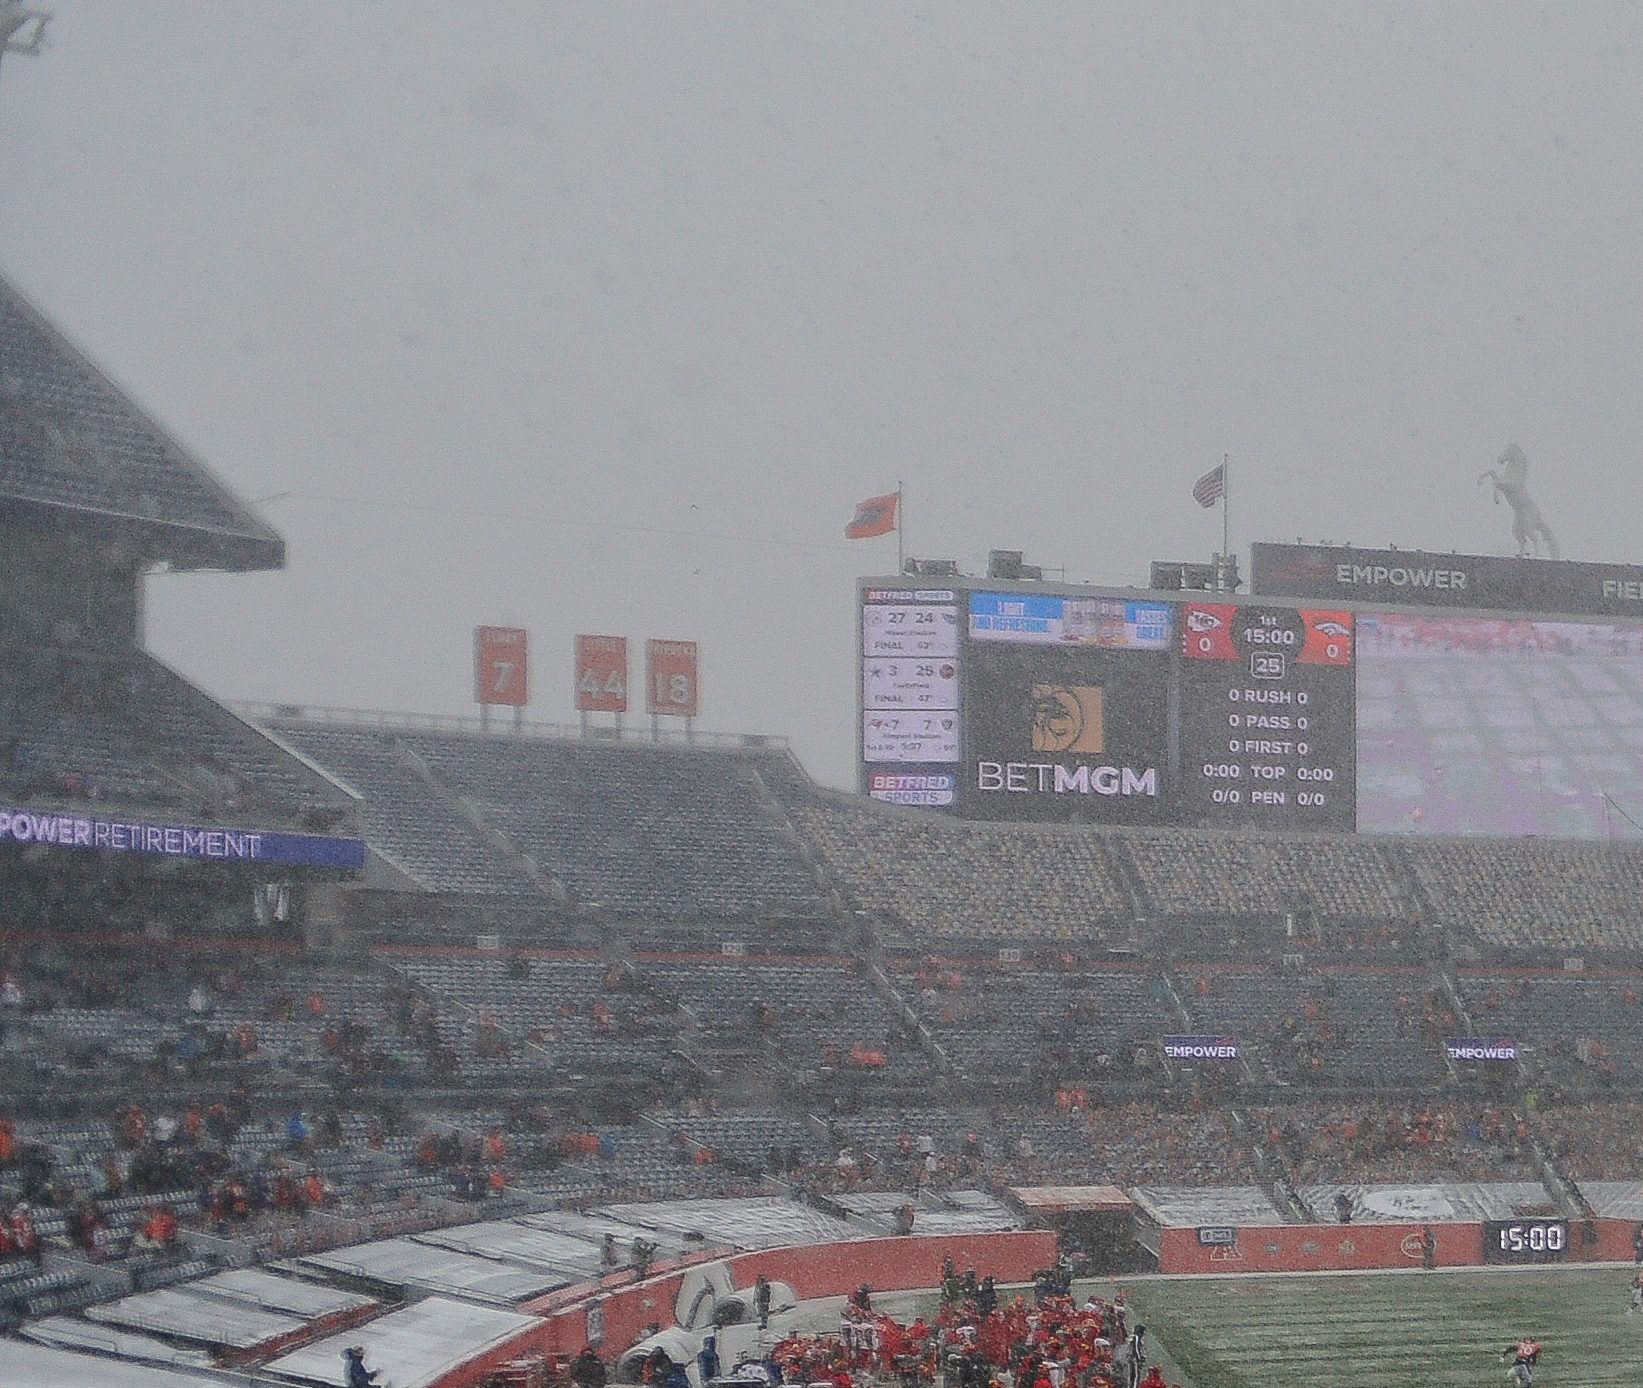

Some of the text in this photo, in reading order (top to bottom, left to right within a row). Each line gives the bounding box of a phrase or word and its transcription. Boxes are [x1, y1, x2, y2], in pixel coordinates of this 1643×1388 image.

[1335, 564, 1467, 591] EMPOWER
[888, 612, 934, 624] 27 24
[1259, 615, 1278, 626] 1st
[1244, 628, 1295, 645] 15:00
[1200, 638, 1212, 652] 0
[1326, 644, 1339, 658] 0
[888, 664, 934, 677] 3 25
[1256, 657, 1281, 674] 25
[493, 660, 516, 693] 7
[578, 668, 627, 700] 44
[655, 671, 689, 703] 18
[1228, 689, 1308, 705] 0 RUSH 0
[924, 719, 931, 730] 7
[1228, 714, 1308, 730] 0 PASS 0
[1229, 740, 1308, 755] 0 FIRST 0
[978, 761, 1155, 796] BETMGM
[1203, 764, 1334, 781] 0:00 TOP 0:00
[873, 776, 950, 789] BETFRED
[884, 792, 938, 803] SPORTS
[1212, 789, 1325, 806] 0/0 PEN 0/0
[94, 820, 262, 860] RETIREMENT
[1166, 1045, 1236, 1059] EMPOWER
[1500, 1225, 1562, 1251] 15:00
